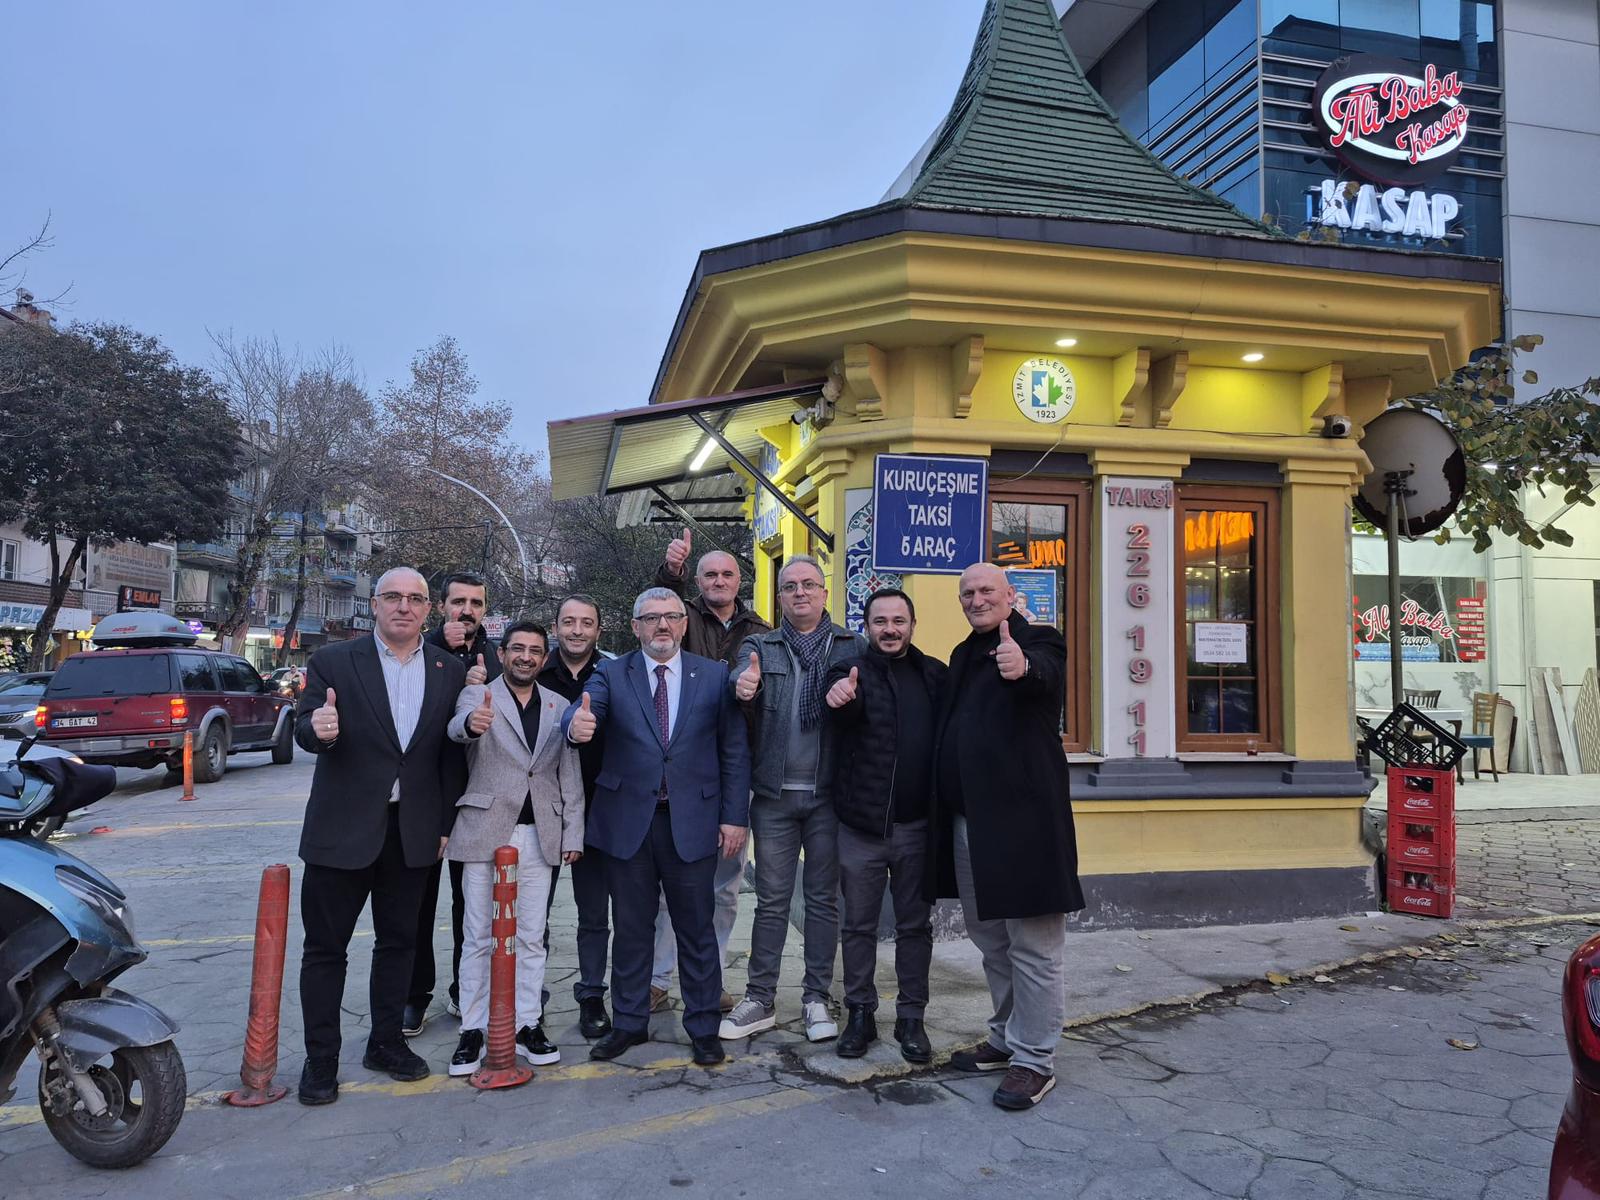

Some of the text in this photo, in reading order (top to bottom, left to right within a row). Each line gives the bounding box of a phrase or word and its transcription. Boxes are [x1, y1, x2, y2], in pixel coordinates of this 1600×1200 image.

[1330, 63, 1462, 147] Ali Baba
[1396, 104, 1470, 165] Kasap
[1321, 179, 1459, 239] KASAP
[1036, 410, 1056, 419] 1923
[883, 470, 979, 498] KURUÇEŞME
[908, 502, 952, 526] TAKSİ
[912, 536, 956, 562] ARAÇ
[1400, 599, 1455, 639] Baba
[87, 717, 96, 725] 42
